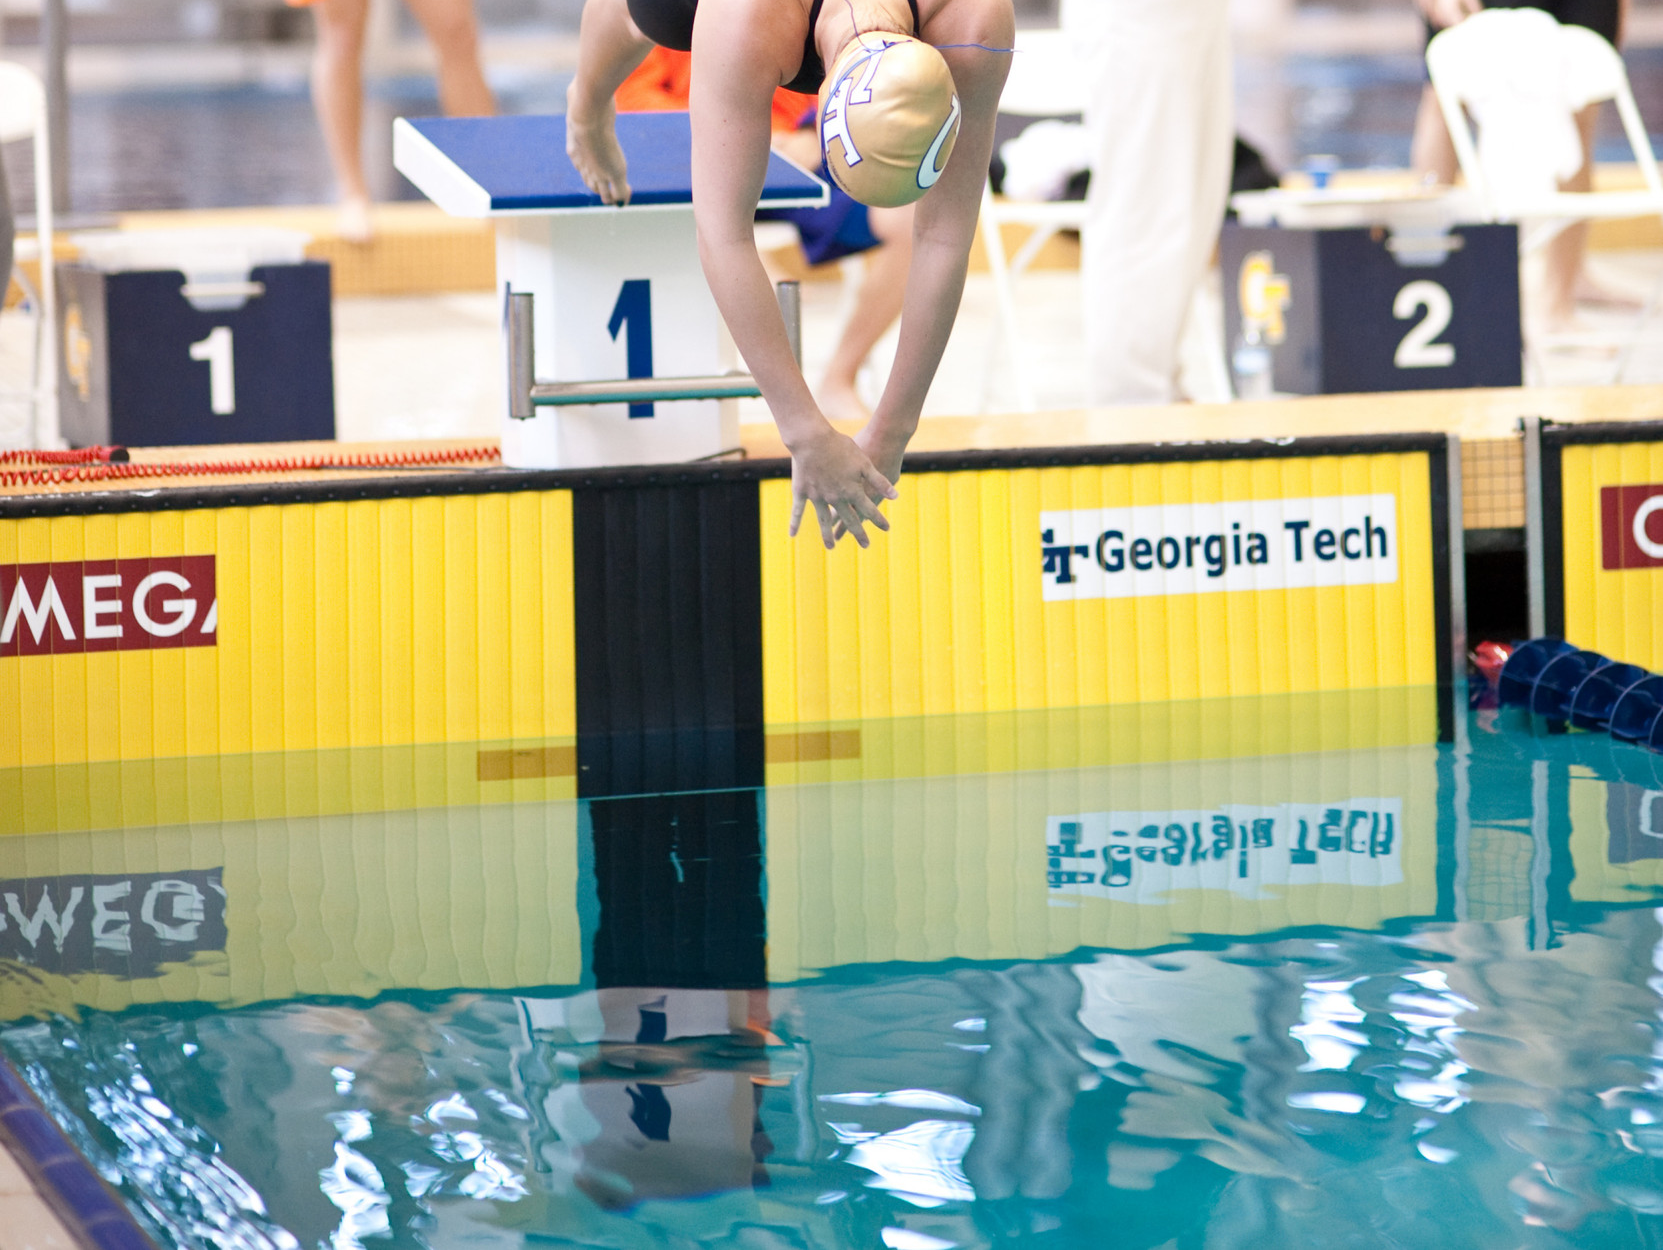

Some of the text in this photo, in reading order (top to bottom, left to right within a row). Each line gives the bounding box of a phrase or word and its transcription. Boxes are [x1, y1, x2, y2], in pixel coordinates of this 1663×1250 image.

[607, 279, 654, 419] 1
[1393, 280, 1455, 368] 2
[189, 326, 235, 415] 1
[1096, 522, 1269, 577] Georgia
[1284, 515, 1388, 563] Tech
